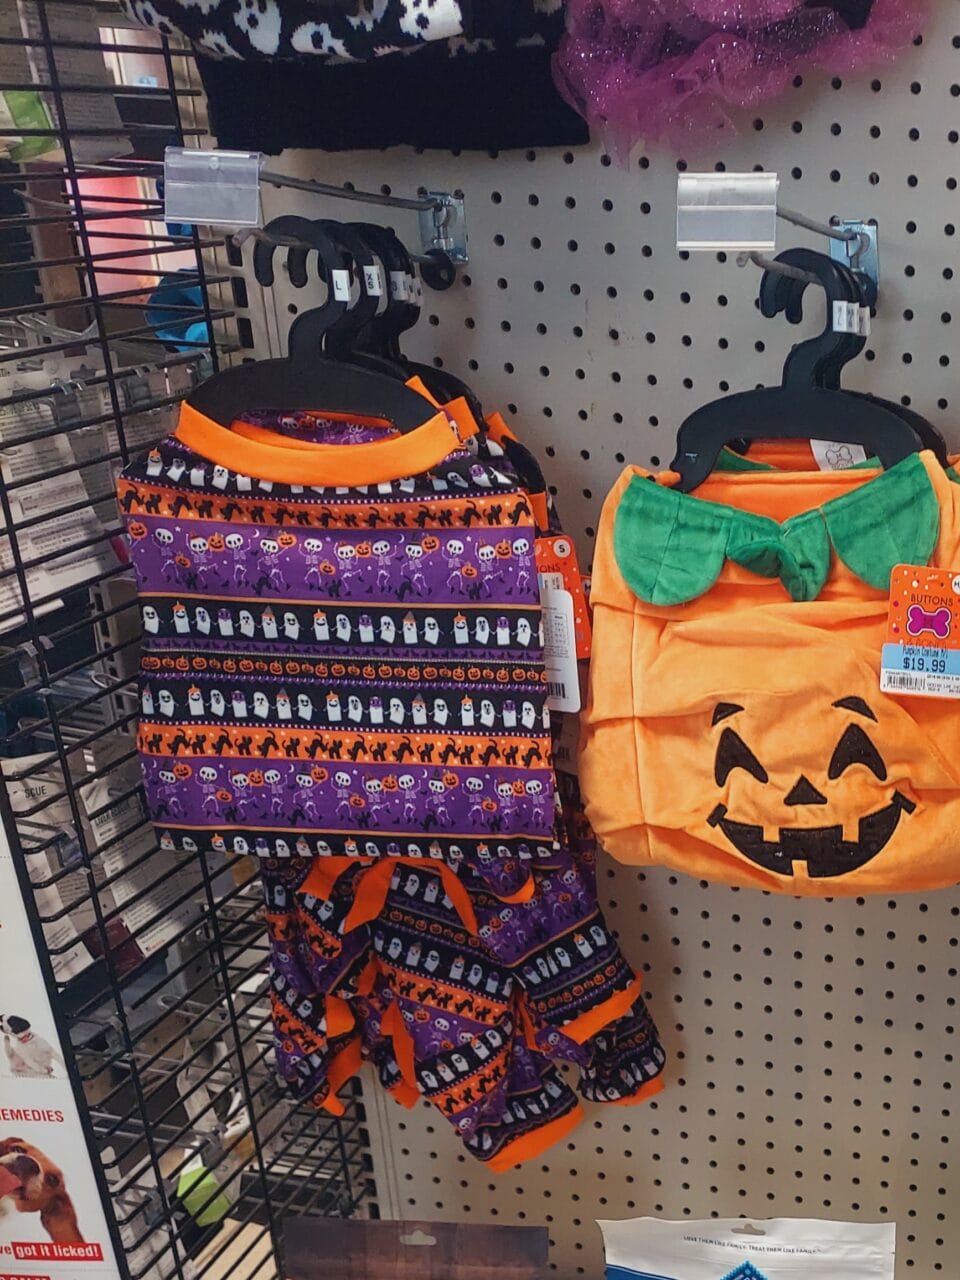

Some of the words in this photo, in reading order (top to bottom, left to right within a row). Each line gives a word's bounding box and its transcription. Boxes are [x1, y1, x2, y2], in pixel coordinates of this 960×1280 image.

[910, 593, 954, 607] BUTTONS
[903, 657, 946, 673] $19.99
[15, 1246, 37, 1258] got
[40, 1246, 50, 1257] it
[53, 1246, 99, 1258] licked!
